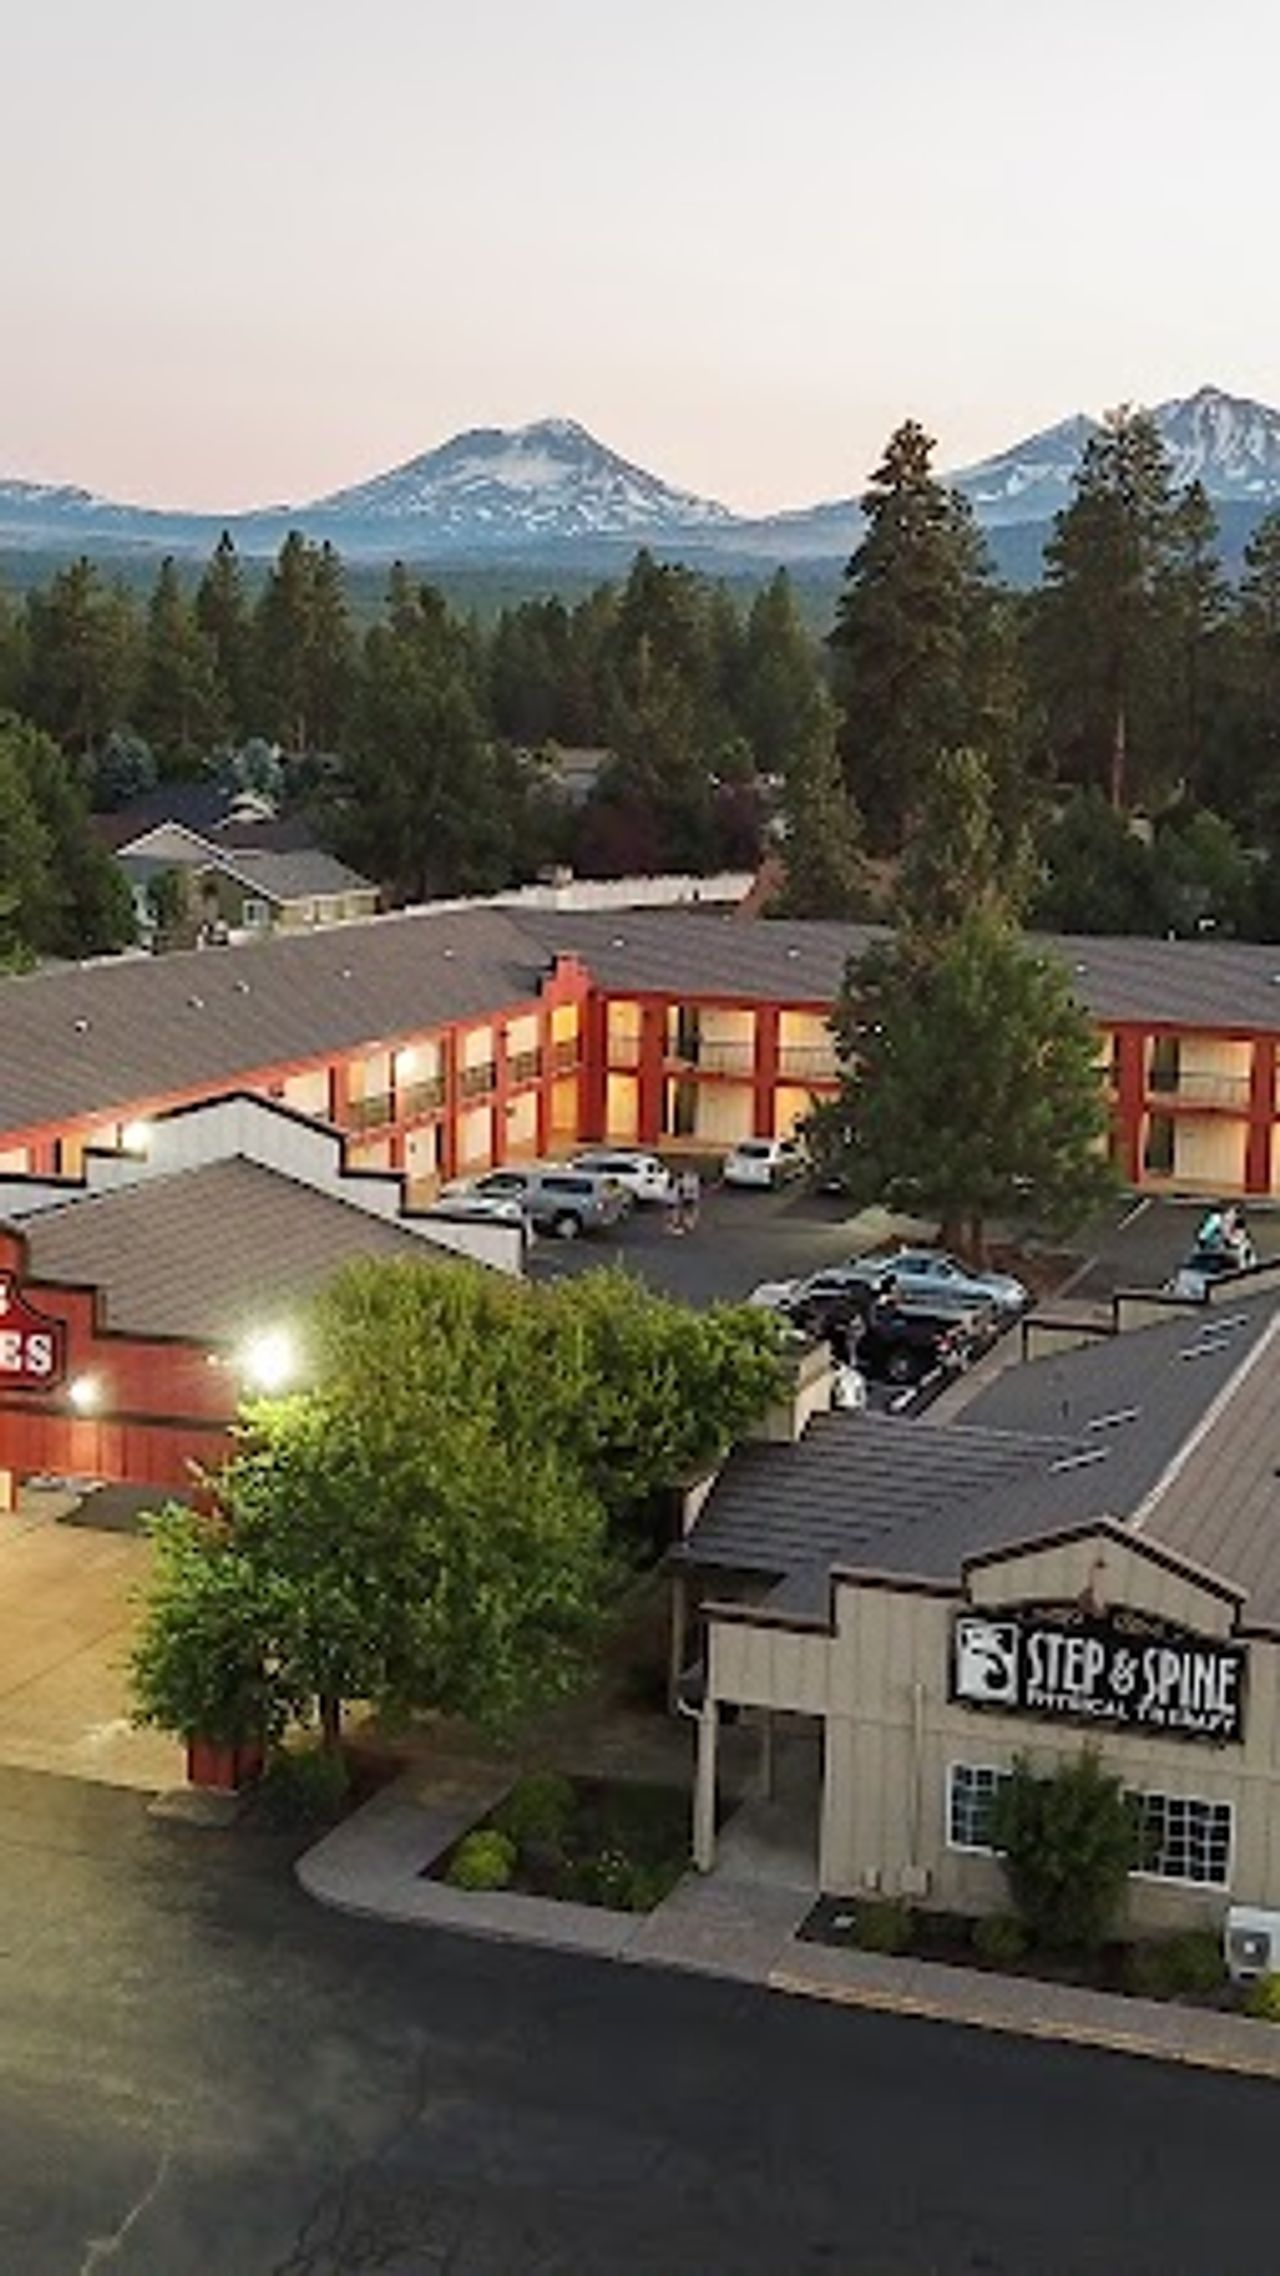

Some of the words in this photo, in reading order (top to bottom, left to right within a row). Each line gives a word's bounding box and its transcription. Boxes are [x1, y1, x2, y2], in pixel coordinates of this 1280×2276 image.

[1026, 1631, 1105, 1695] STEP
[1108, 1649, 1138, 1695] &
[1142, 1648, 1239, 1715] SPINE
[1026, 1689, 1129, 1720] PHYSICAL
[1136, 1704, 1236, 1732] THERAPY
